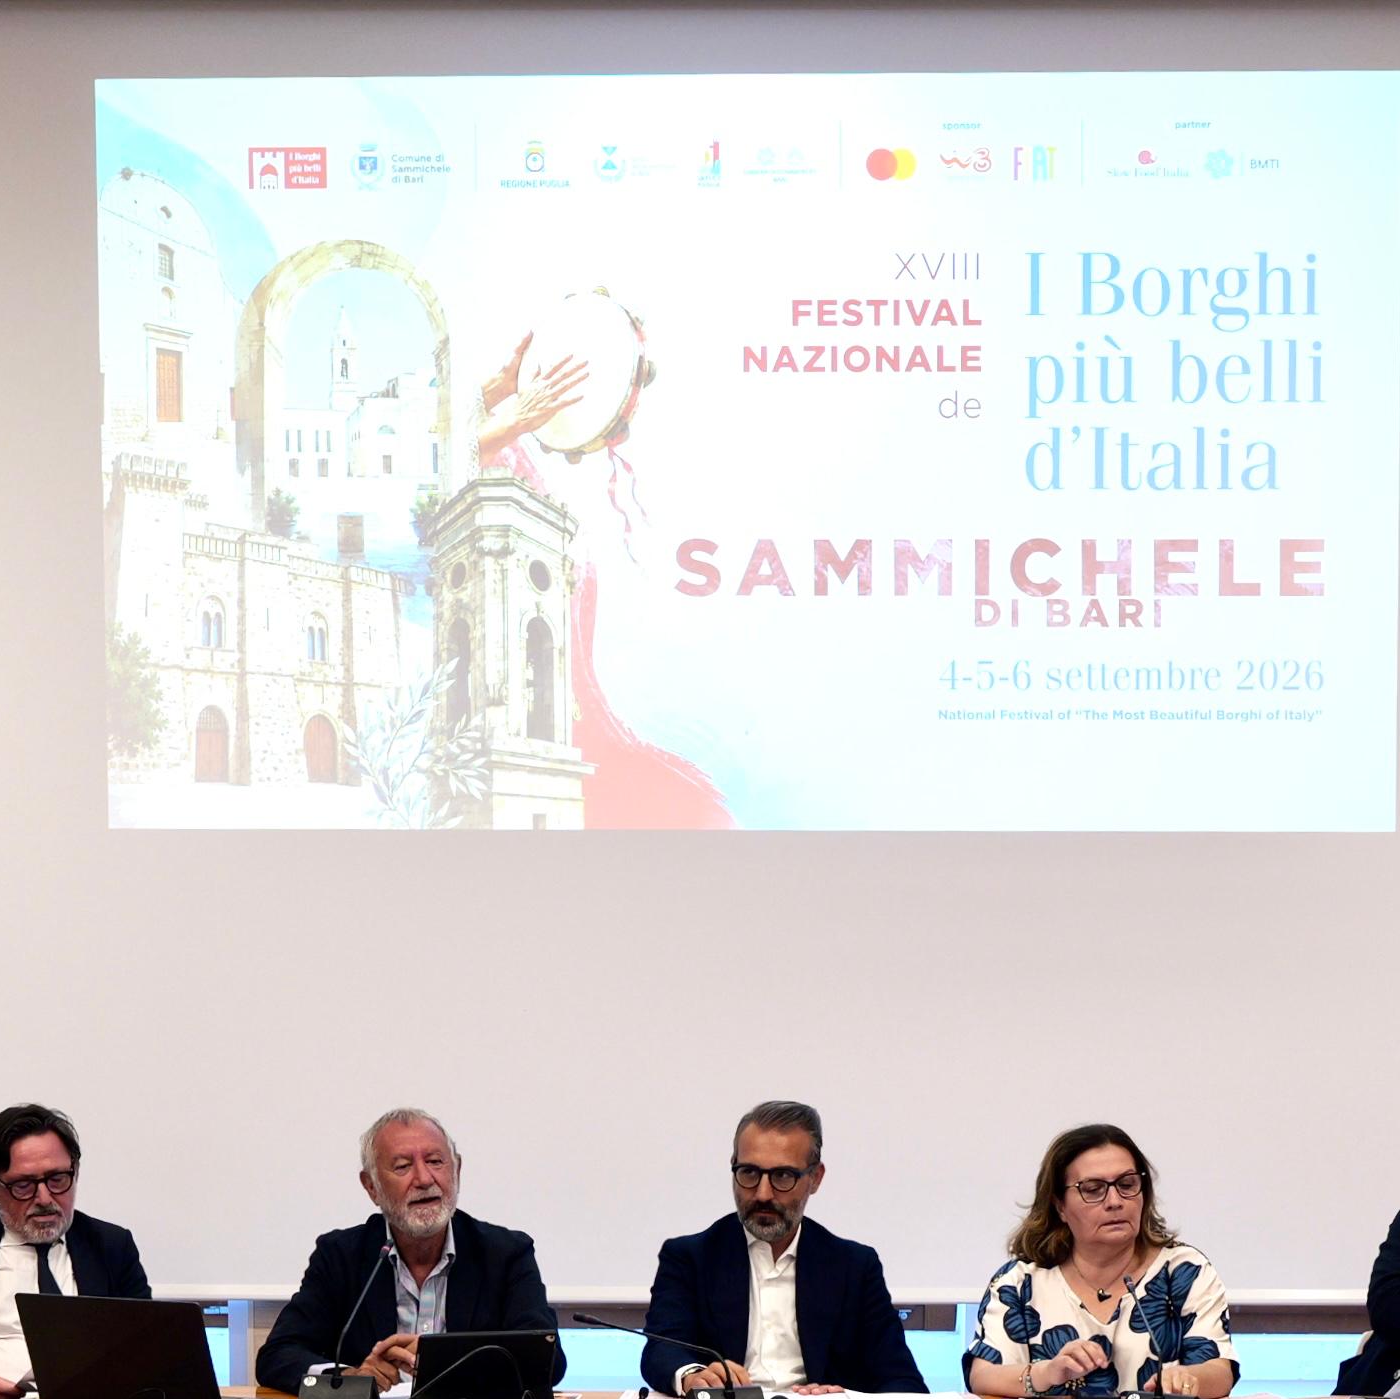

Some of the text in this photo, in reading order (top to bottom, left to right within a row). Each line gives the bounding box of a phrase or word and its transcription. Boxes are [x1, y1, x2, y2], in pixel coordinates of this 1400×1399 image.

[942, 121, 981, 131] sponsor
[1174, 120, 1212, 130] partner
[391, 154, 445, 163] Comune di
[391, 165, 451, 173] Sammichele
[1249, 158, 1280, 170] BMTI
[391, 175, 424, 184] di Bari
[500, 179, 570, 188] REGIONE PUGLIA
[894, 252, 981, 281] XVIII
[1024, 251, 1320, 333] I Borghi
[791, 299, 983, 327] FESTIVAL
[742, 345, 983, 374] NAZIONALE
[1024, 335, 1327, 419] più belli
[937, 390, 982, 420] de
[673, 537, 1326, 598] SAMMICHELE
[974, 598, 1163, 629] DI BARI
[937, 658, 1325, 693] 4-5-6 settembre 2026
[937, 708, 996, 721] National
[1000, 708, 1054, 721] Festival
[1057, 708, 1072, 721] of
[1112, 708, 1146, 721] Most
[1149, 708, 1212, 721] Beautiful
[1215, 708, 1262, 723] Borghi
[1265, 708, 1280, 721] of
